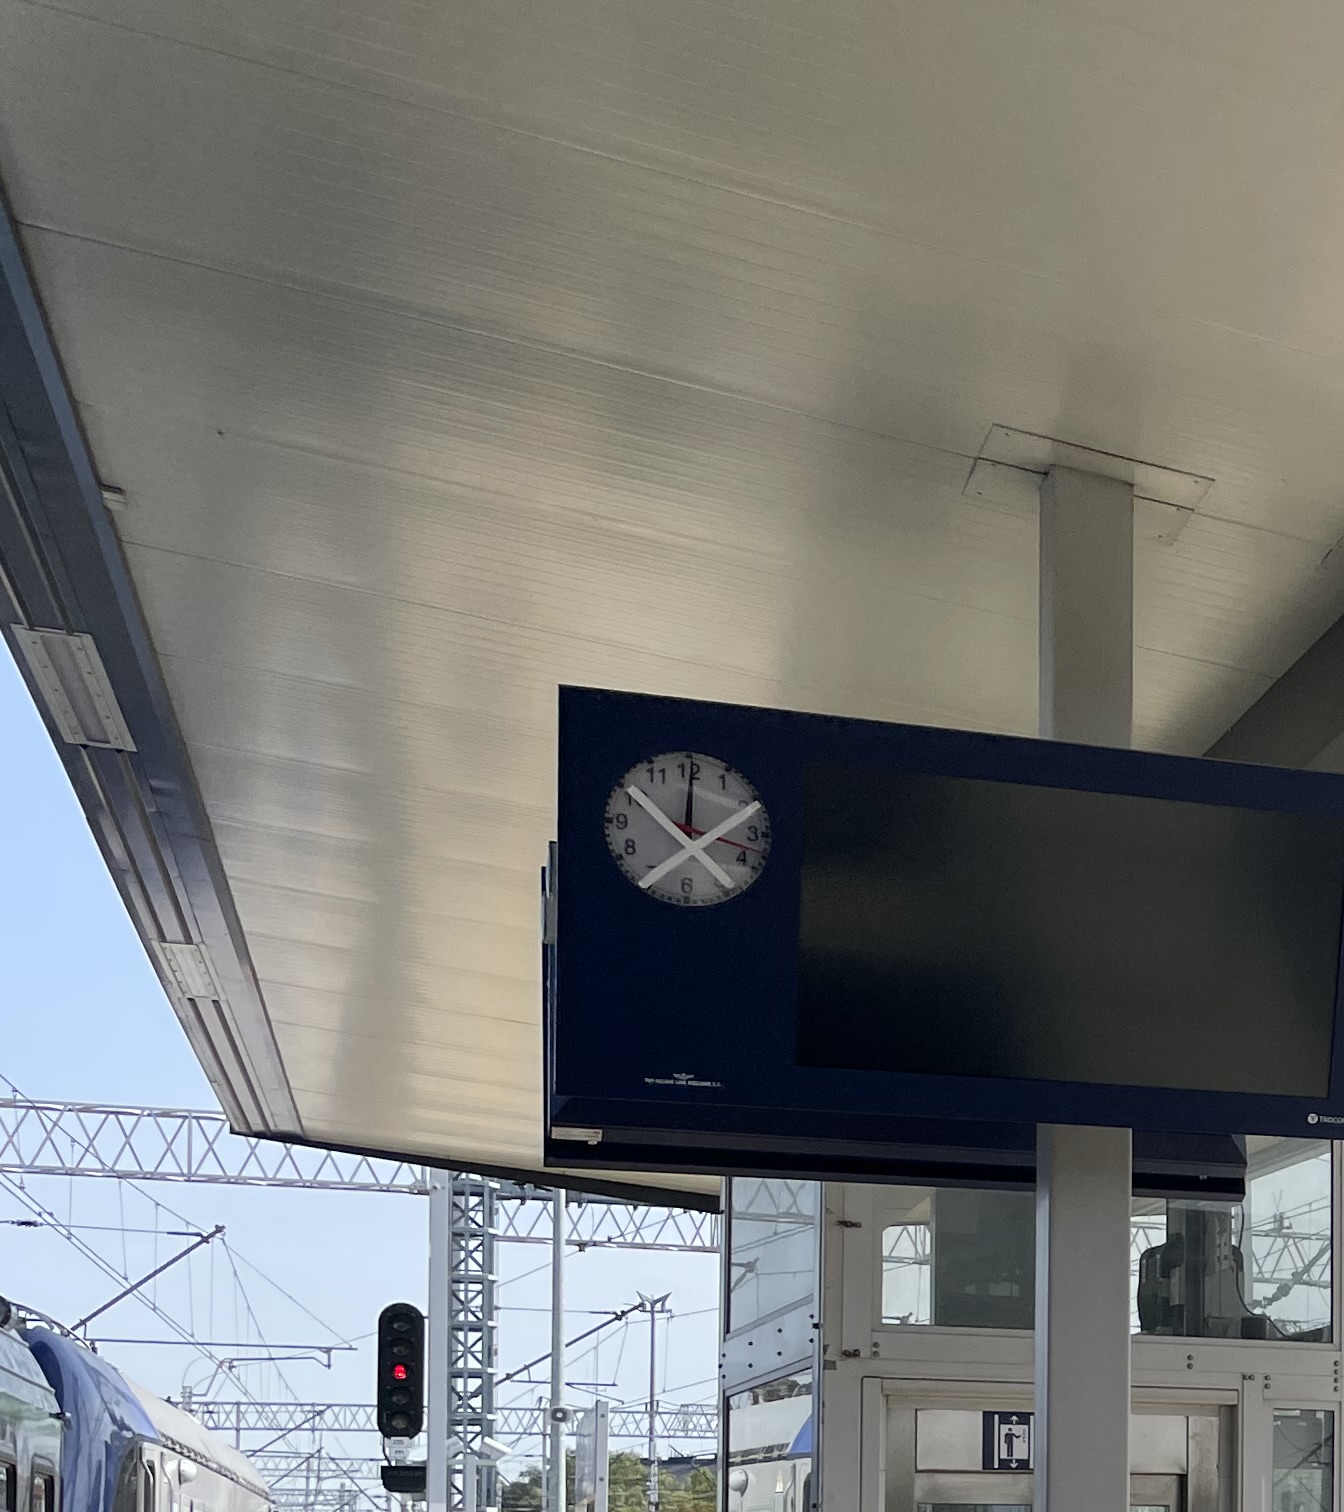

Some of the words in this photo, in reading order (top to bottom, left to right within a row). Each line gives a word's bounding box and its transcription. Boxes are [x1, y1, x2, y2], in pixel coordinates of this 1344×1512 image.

[647, 766, 667, 784] 11
[677, 762, 701, 781] 12
[718, 773, 727, 791] 1
[615, 813, 628, 830] 9
[747, 825, 759, 842] 3
[624, 838, 637, 856] 8
[735, 849, 748, 867] 4
[681, 877, 693, 894] 6
